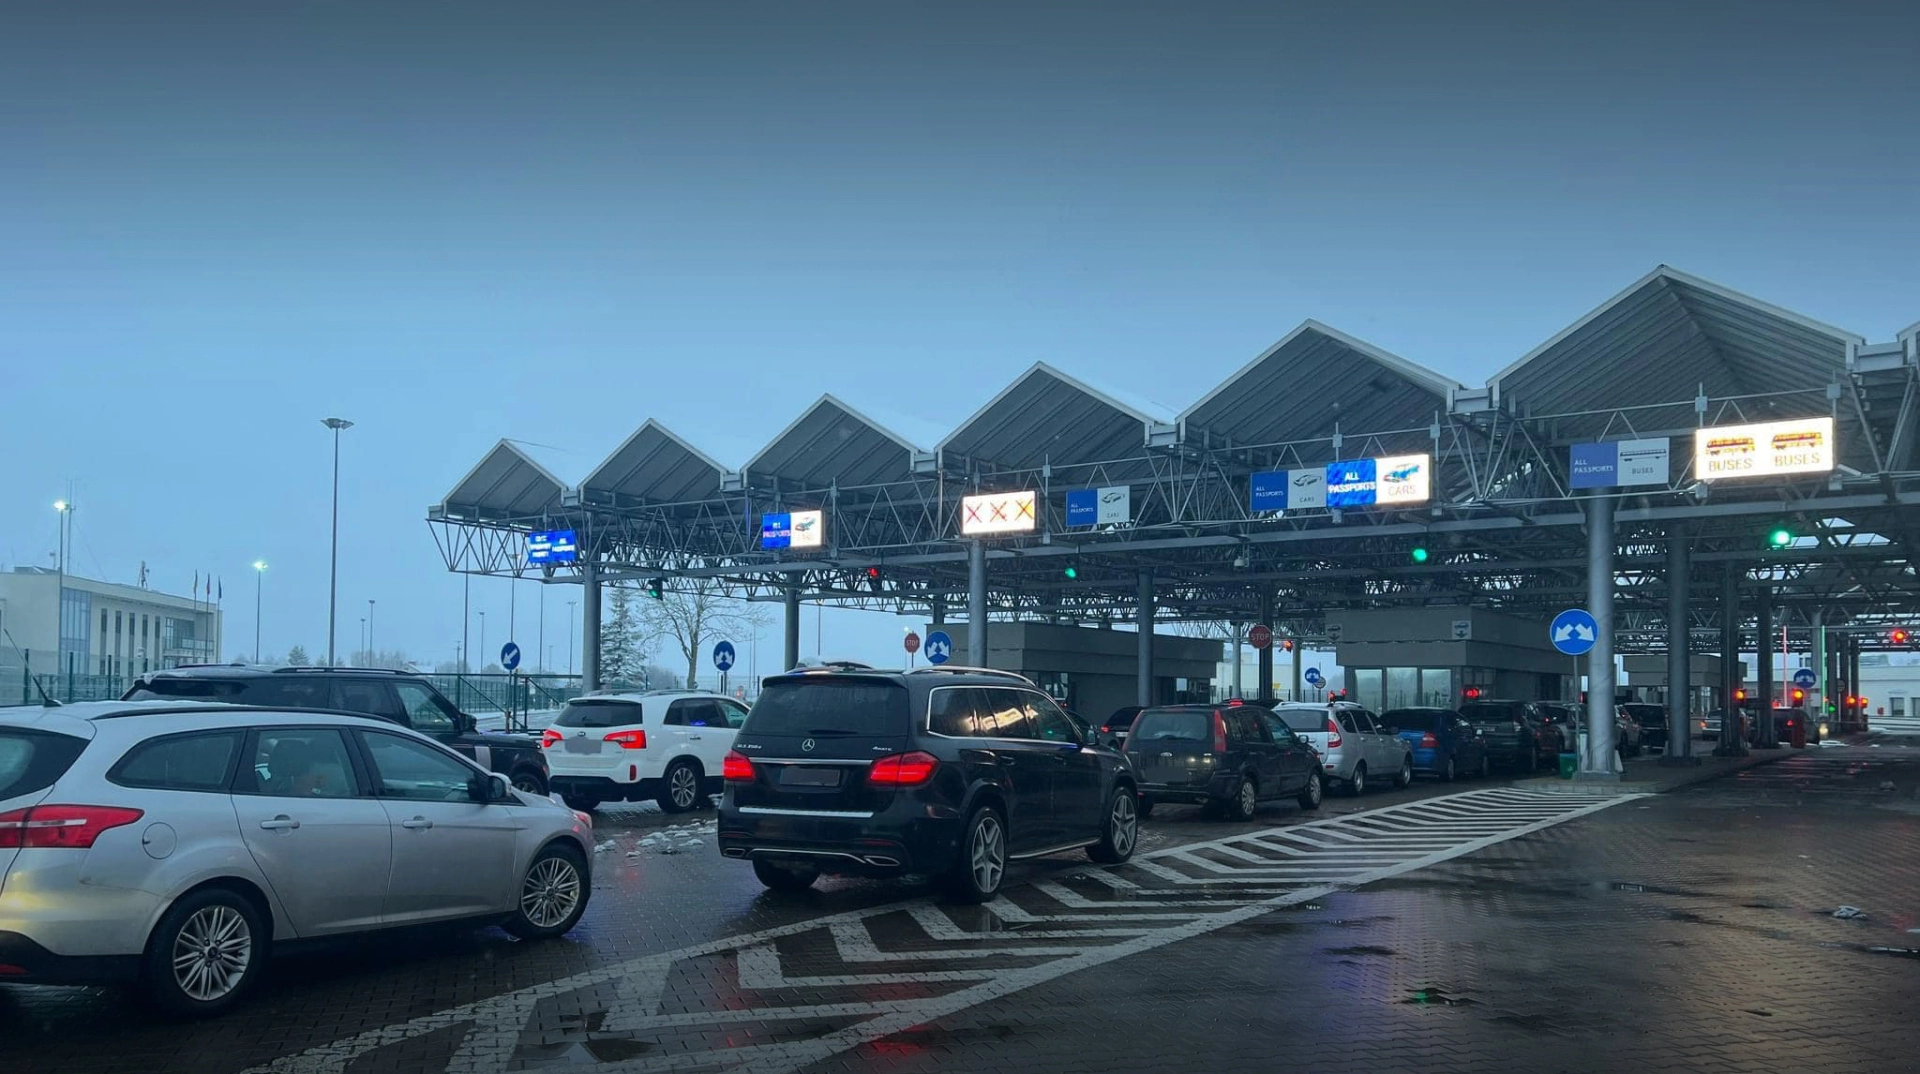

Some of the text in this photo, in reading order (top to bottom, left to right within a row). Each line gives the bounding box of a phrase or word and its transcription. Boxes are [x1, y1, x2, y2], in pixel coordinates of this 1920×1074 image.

[1774, 453, 1820, 466] BUSES
[1574, 465, 1614, 473] PASSPORTS
[1708, 458, 1752, 472] BUSES
[1632, 467, 1654, 475] BUSES
[1344, 472, 1359, 481] ALL
[1328, 481, 1376, 494] PASSPORTS
[1388, 485, 1416, 496] CARS
[1251, 633, 1269, 641] STOP
